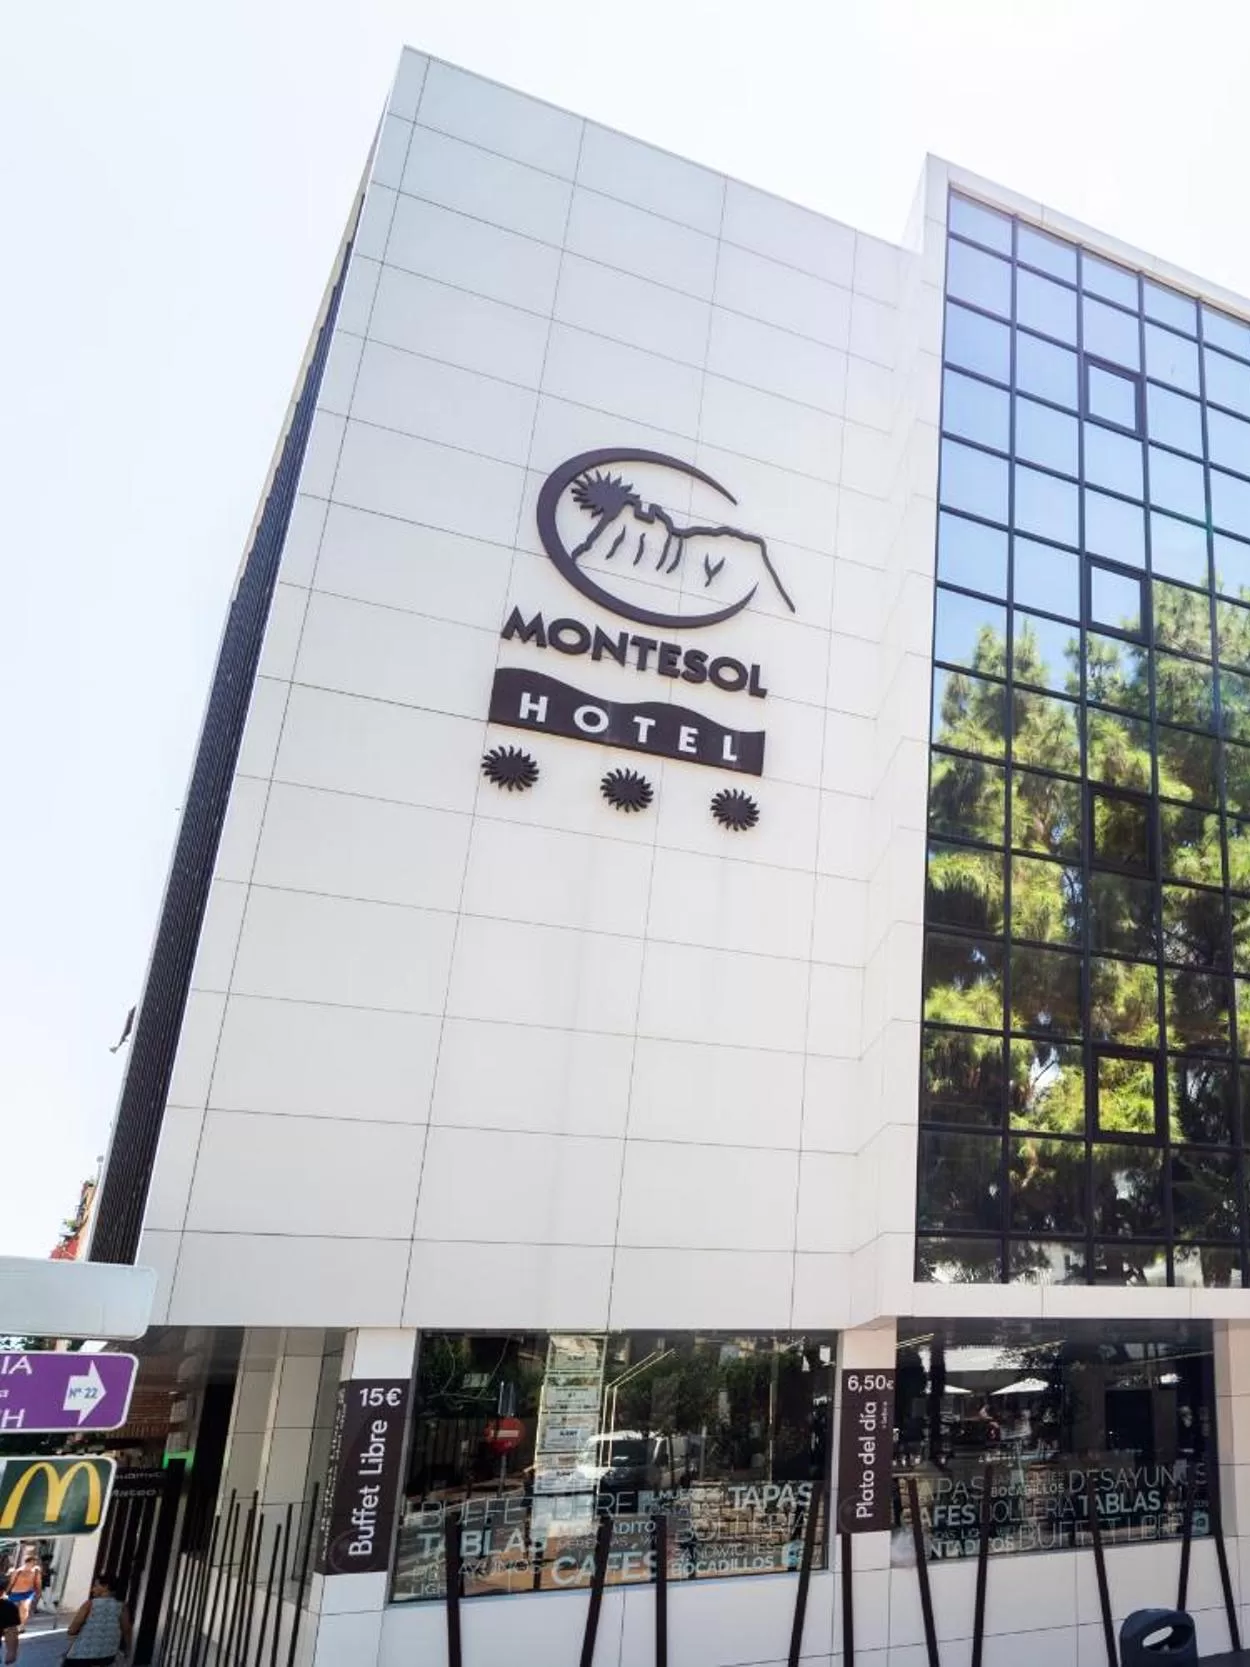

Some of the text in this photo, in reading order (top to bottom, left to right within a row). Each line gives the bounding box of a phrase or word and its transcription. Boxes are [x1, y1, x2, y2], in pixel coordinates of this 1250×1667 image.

[501, 605, 768, 699] MONTESOL
[518, 692, 738, 762] HOTEL
[359, 1387, 402, 1407] 15€
[847, 1374, 895, 1392] 6,50€
[0, 1408, 25, 1428] H
[856, 1401, 878, 1519] Plato del día
[348, 1419, 388, 1557] Buffet Libre
[728, 1482, 814, 1511] TAPAS
[670, 1555, 774, 1576] BOCADILLOS
